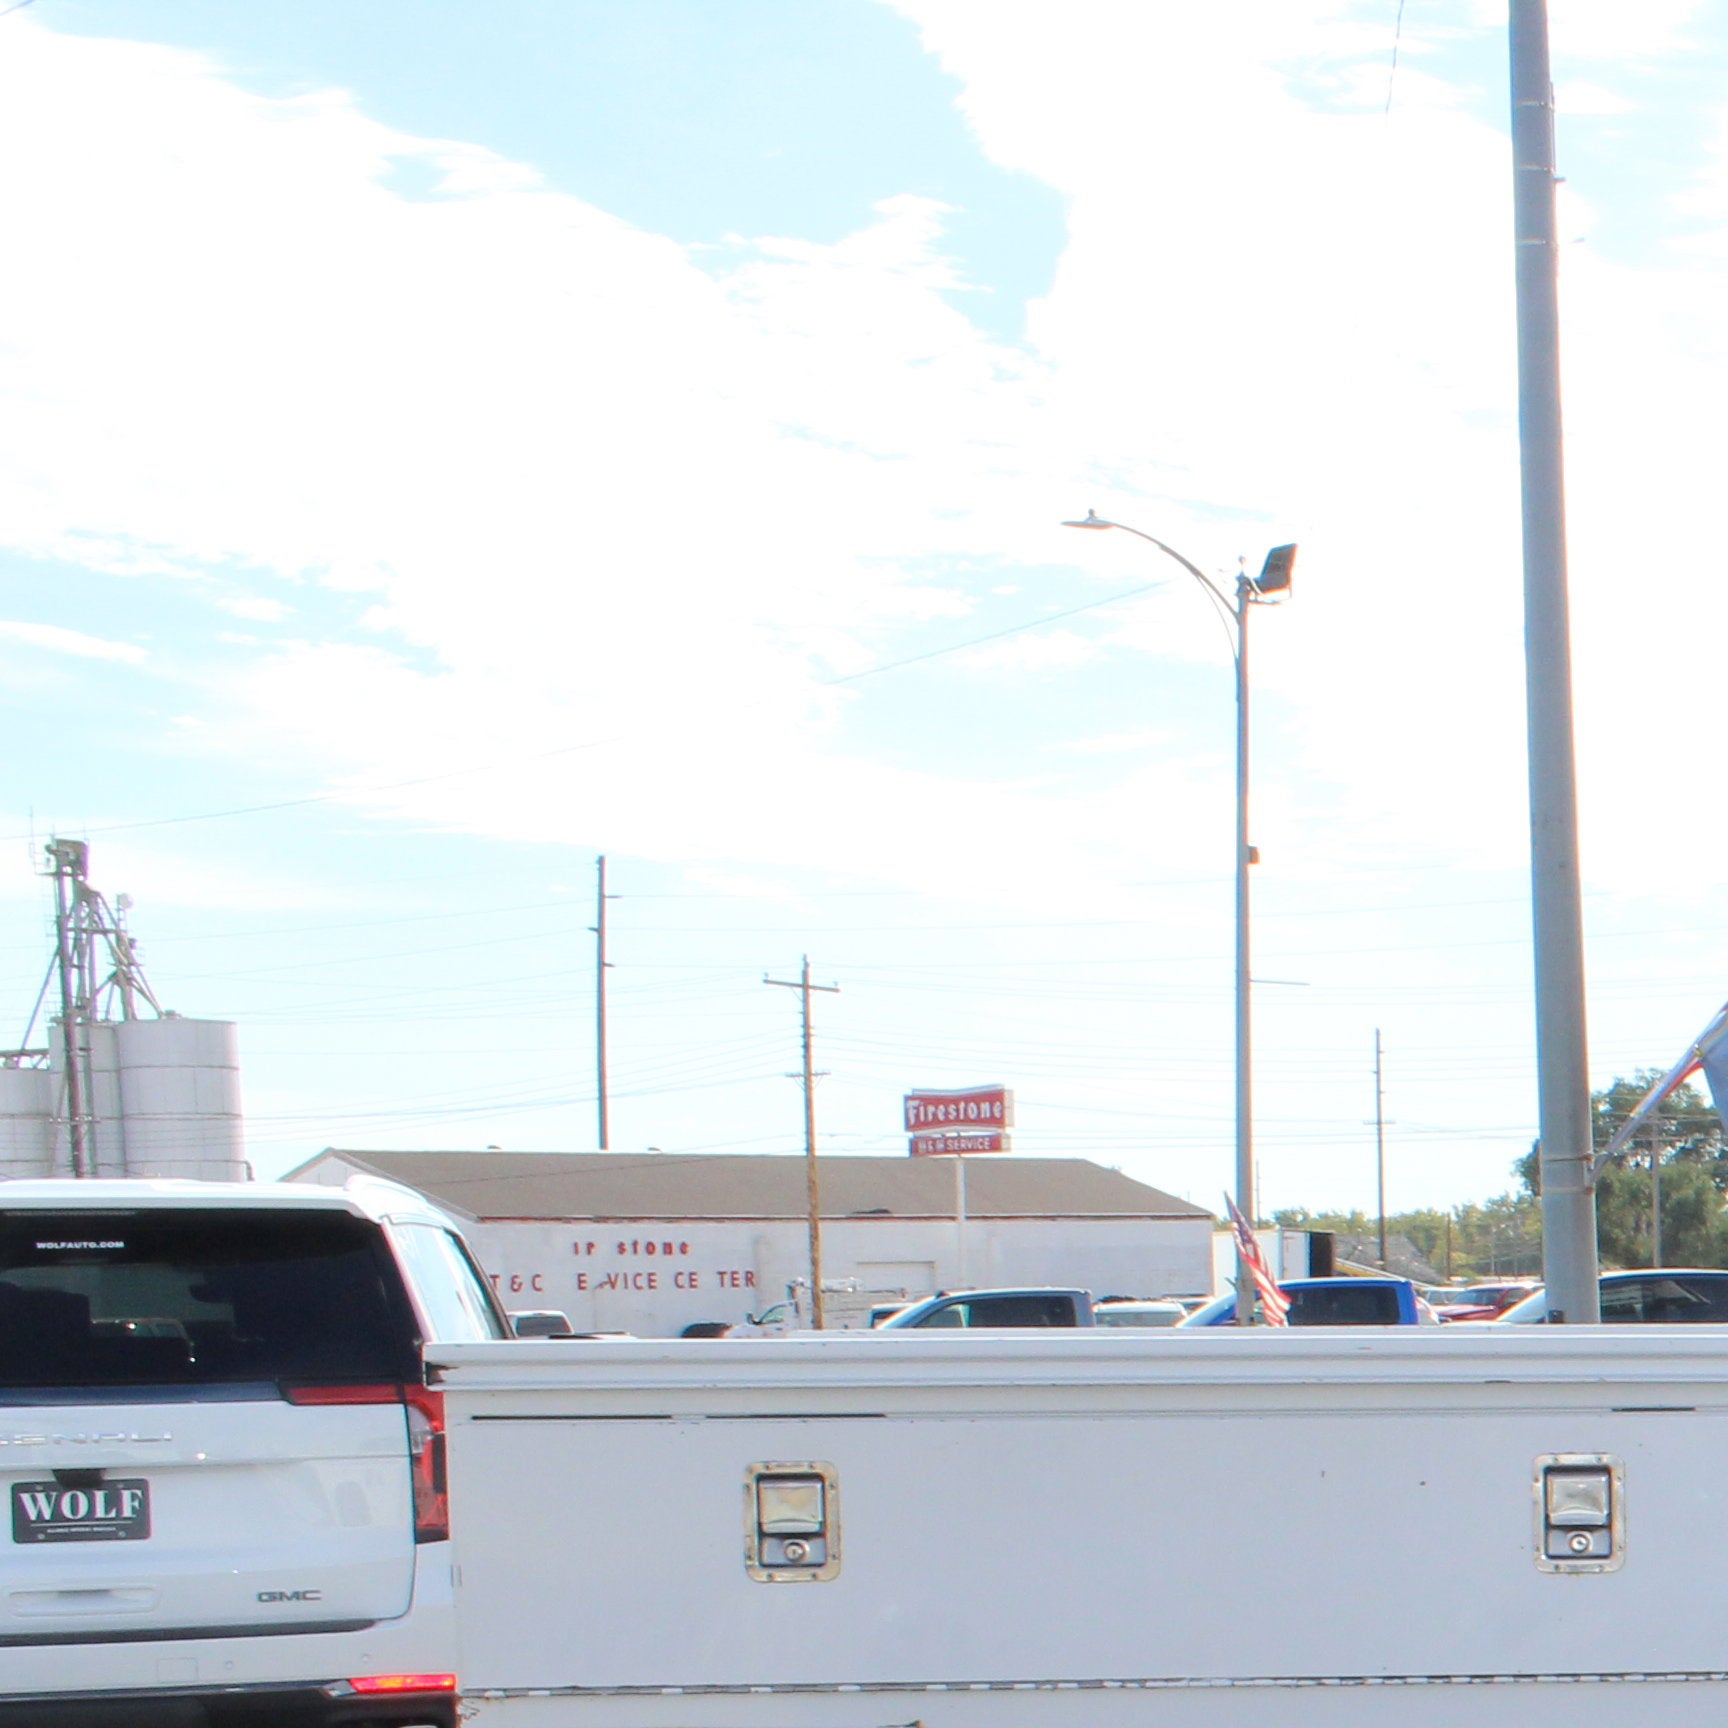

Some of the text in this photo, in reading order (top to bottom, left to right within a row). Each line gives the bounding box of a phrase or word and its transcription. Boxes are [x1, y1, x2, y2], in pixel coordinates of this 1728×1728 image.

[907, 1100, 1003, 1124] Firestone
[946, 1138, 991, 1152] SERVICE
[36, 1241, 125, 1250] WOLFAUTO.COM
[0, 1432, 173, 1446] ENALI
[18, 1489, 143, 1521] WOLF
[257, 1589, 323, 1602] GMC
